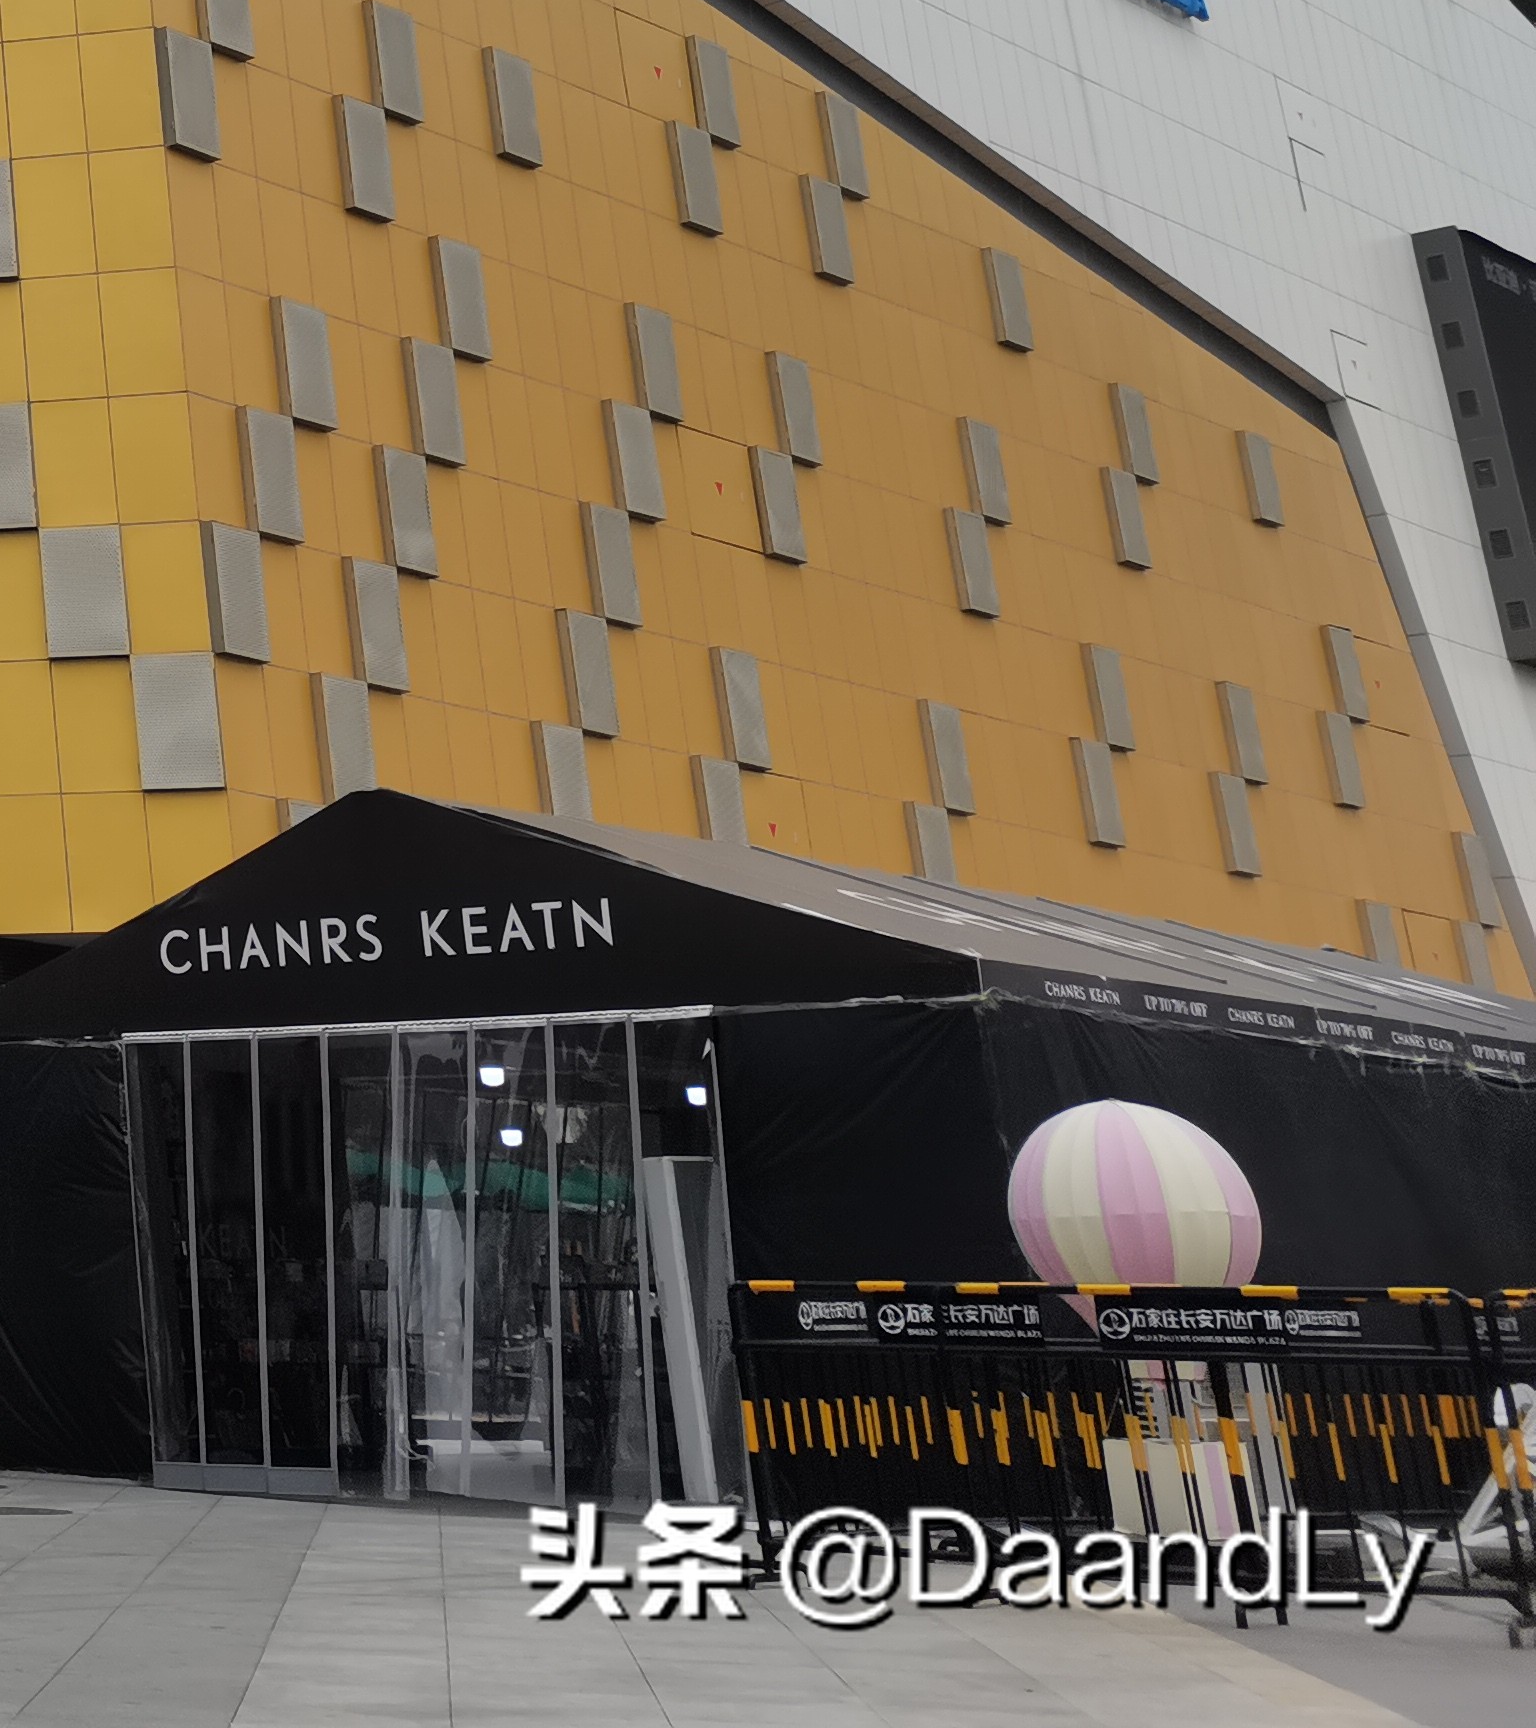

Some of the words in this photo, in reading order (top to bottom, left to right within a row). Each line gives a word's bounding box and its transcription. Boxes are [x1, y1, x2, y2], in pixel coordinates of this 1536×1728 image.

[159, 913, 383, 976] CHANRS
[418, 896, 615, 959] KEATN
[906, 1303, 1040, 1325] 石家长安万达广场
[1129, 1307, 1283, 1331] 石家庄长安万达广场
